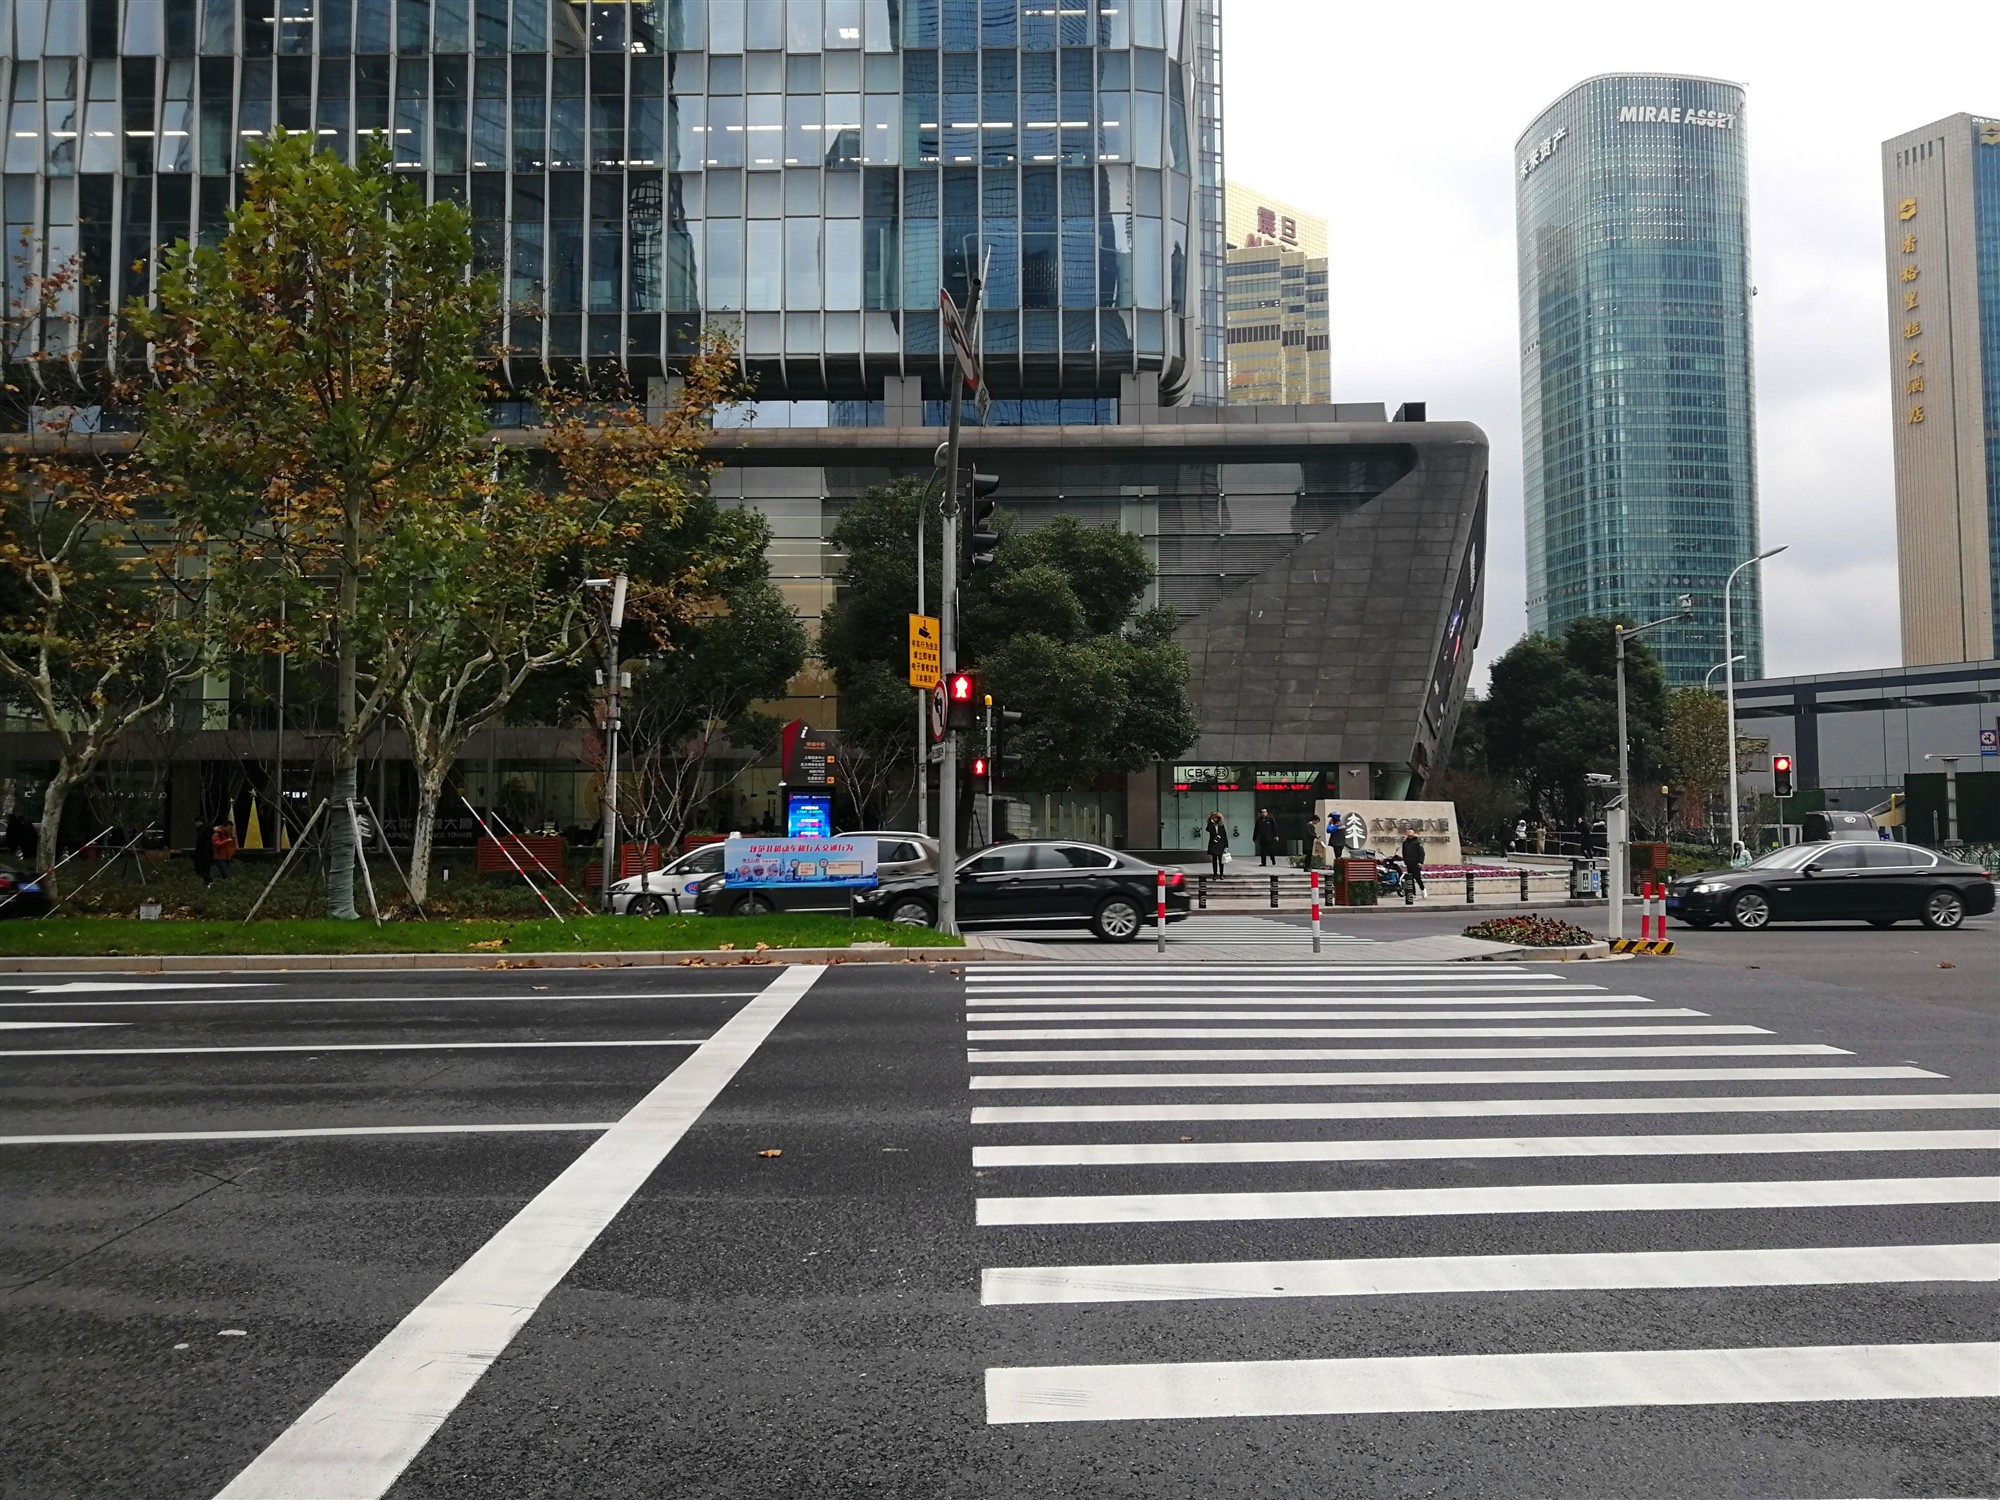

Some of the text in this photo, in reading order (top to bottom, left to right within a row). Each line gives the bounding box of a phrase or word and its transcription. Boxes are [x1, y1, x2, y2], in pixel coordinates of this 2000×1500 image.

[1620, 106, 1737, 129] MIRAE ASSET
[1519, 127, 1568, 181] 未来资产
[1257, 206, 1299, 247] 震旦
[1900, 233, 1925, 424] 香格里拉大酒店
[1184, 768, 1210, 777] ICBC
